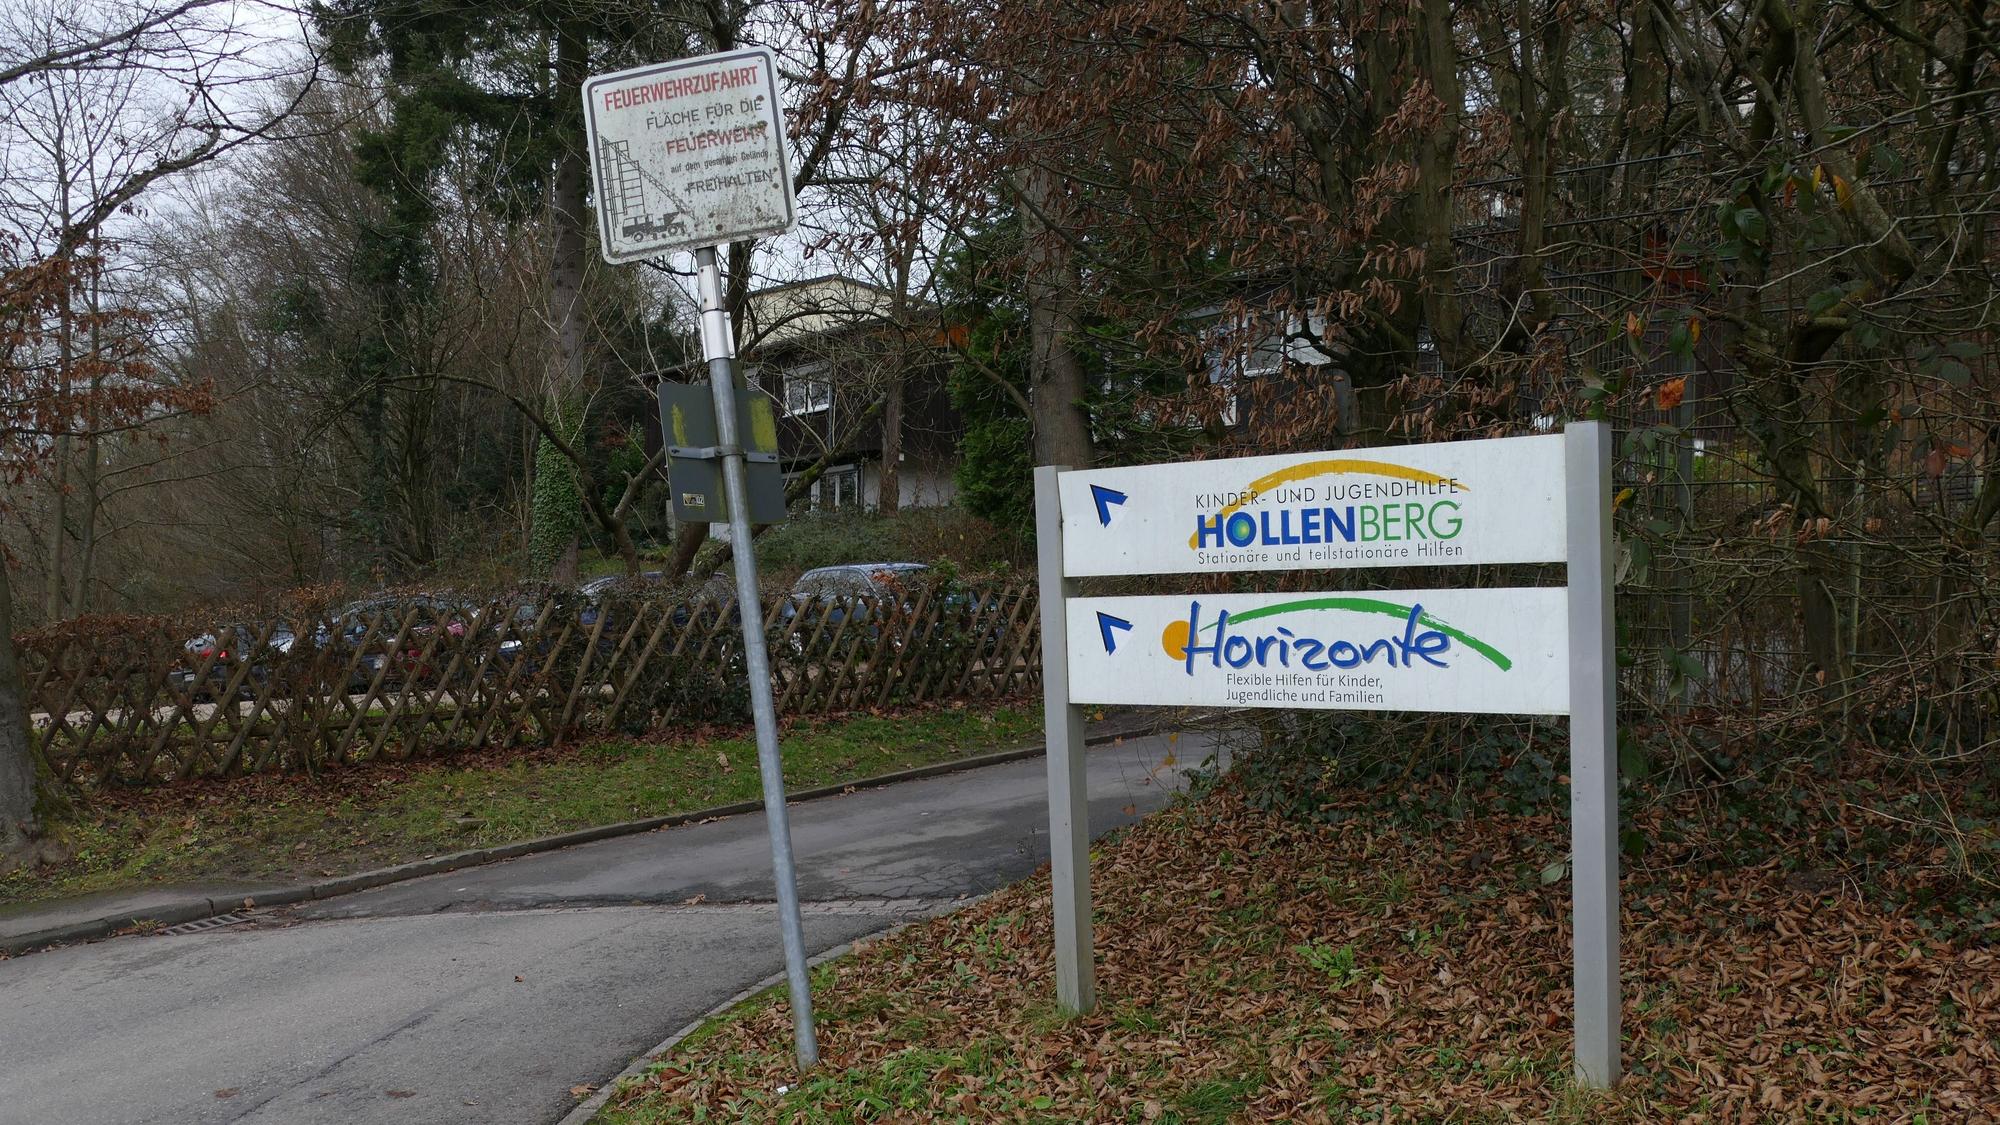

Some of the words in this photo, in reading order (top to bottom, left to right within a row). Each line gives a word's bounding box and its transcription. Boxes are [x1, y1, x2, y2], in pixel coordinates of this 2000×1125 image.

[604, 66, 758, 112] FEUERWEHRZUFAHRT
[646, 109, 700, 130] FLÄCHE
[705, 102, 734, 119] FÜR
[740, 98, 762, 114] DIE
[666, 127, 768, 155] FEUERWEHR
[671, 162, 682, 174] auf
[685, 161, 701, 172] dem
[686, 169, 774, 195] FREIHALTEN
[1195, 490, 1267, 509] KINDER-
[1276, 487, 1316, 504] UND
[1325, 478, 1458, 501] JUGENDHILFE
[1197, 500, 1463, 549] HOLLENBERG
[1198, 549, 1269, 565] Stationäre
[1276, 546, 1301, 561] und
[1309, 544, 1409, 560] teilstationäre
[1417, 540, 1463, 557] Hilfen
[1180, 600, 1452, 677] Horizonte
[1226, 673, 1272, 686] Flexible
[1275, 674, 1312, 687] Hilfen
[1316, 674, 1335, 687] für
[1338, 675, 1383, 689] Kinder,
[1226, 689, 1298, 704] Jugendliche
[1301, 690, 1325, 702] und
[1329, 690, 1384, 703] Familien
